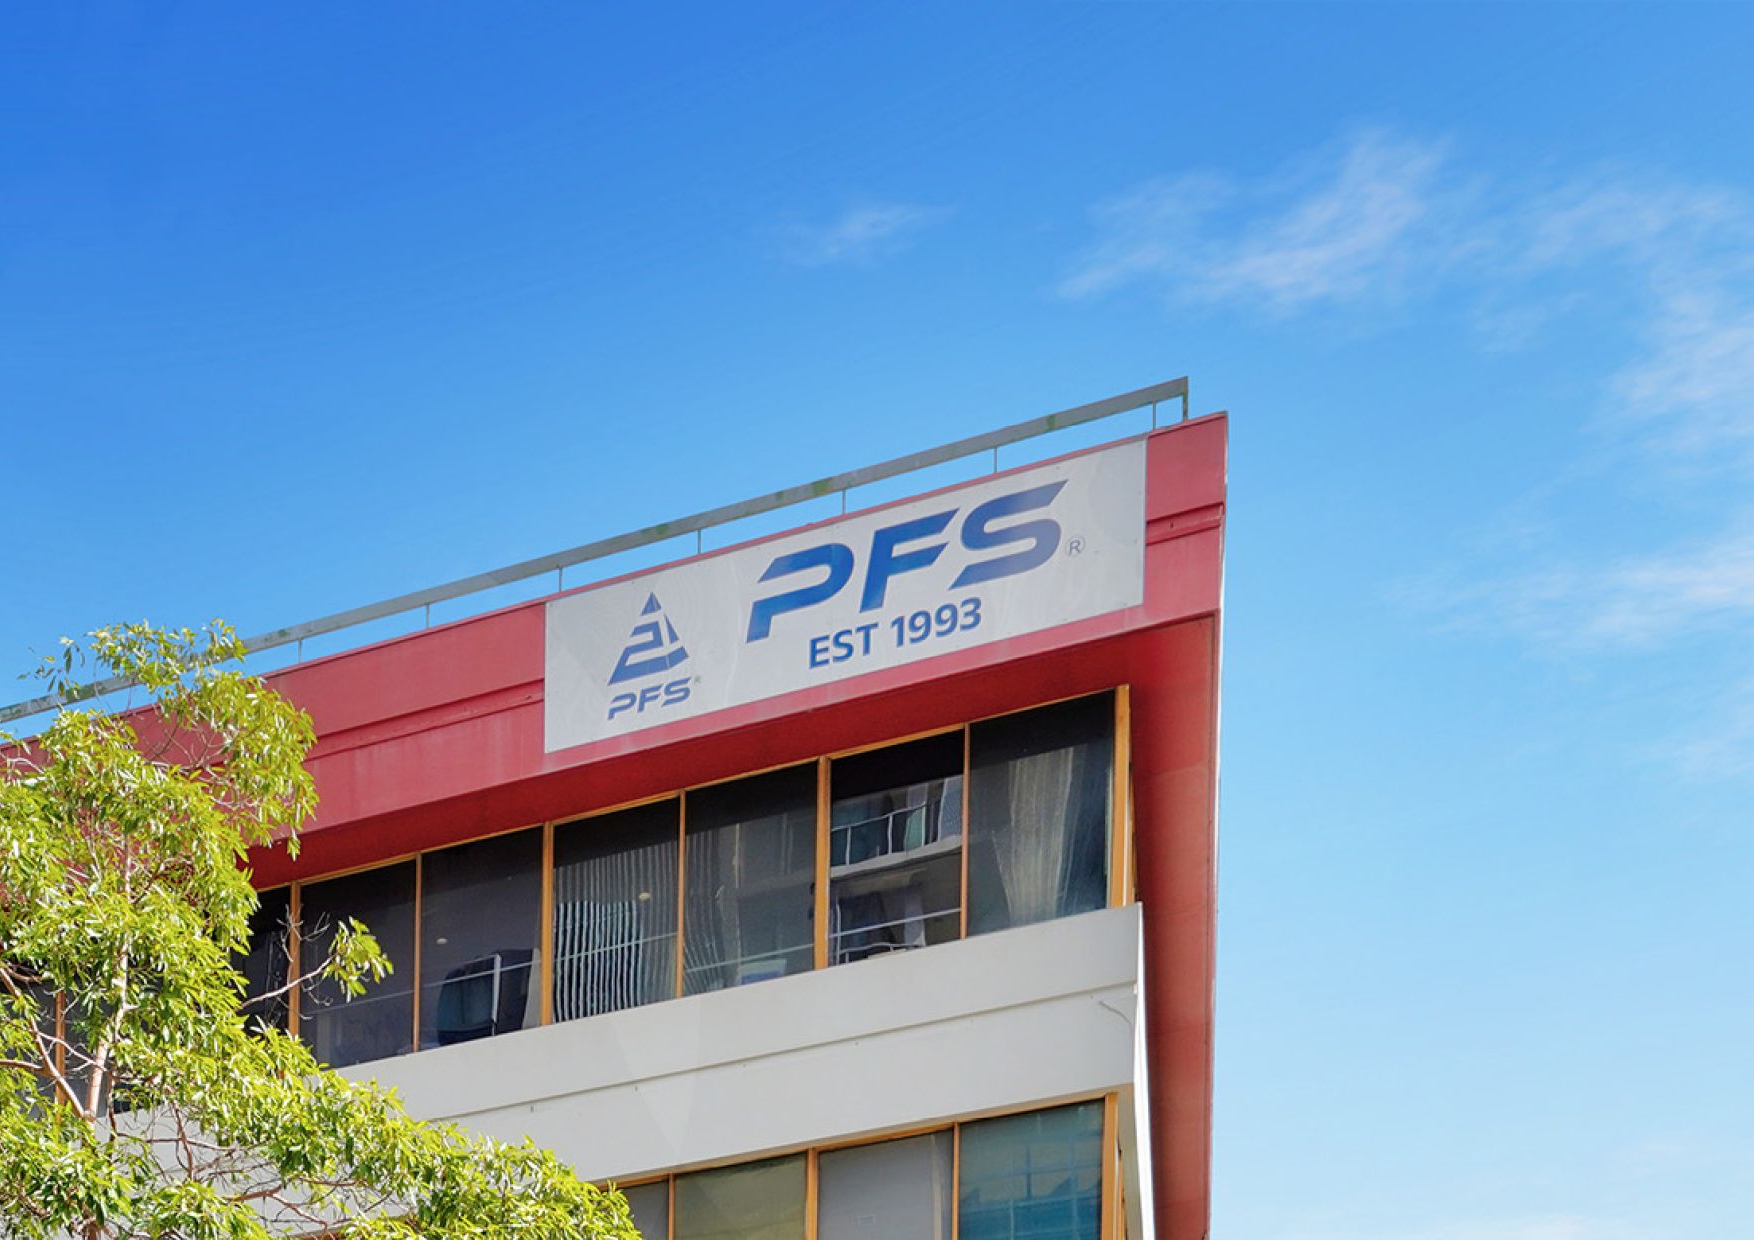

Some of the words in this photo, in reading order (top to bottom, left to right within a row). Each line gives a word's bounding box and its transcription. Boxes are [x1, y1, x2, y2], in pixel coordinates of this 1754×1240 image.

[747, 480, 1068, 643] PFS
[808, 623, 878, 669] EST
[891, 597, 981, 647] 1993
[607, 677, 692, 720] PFS
